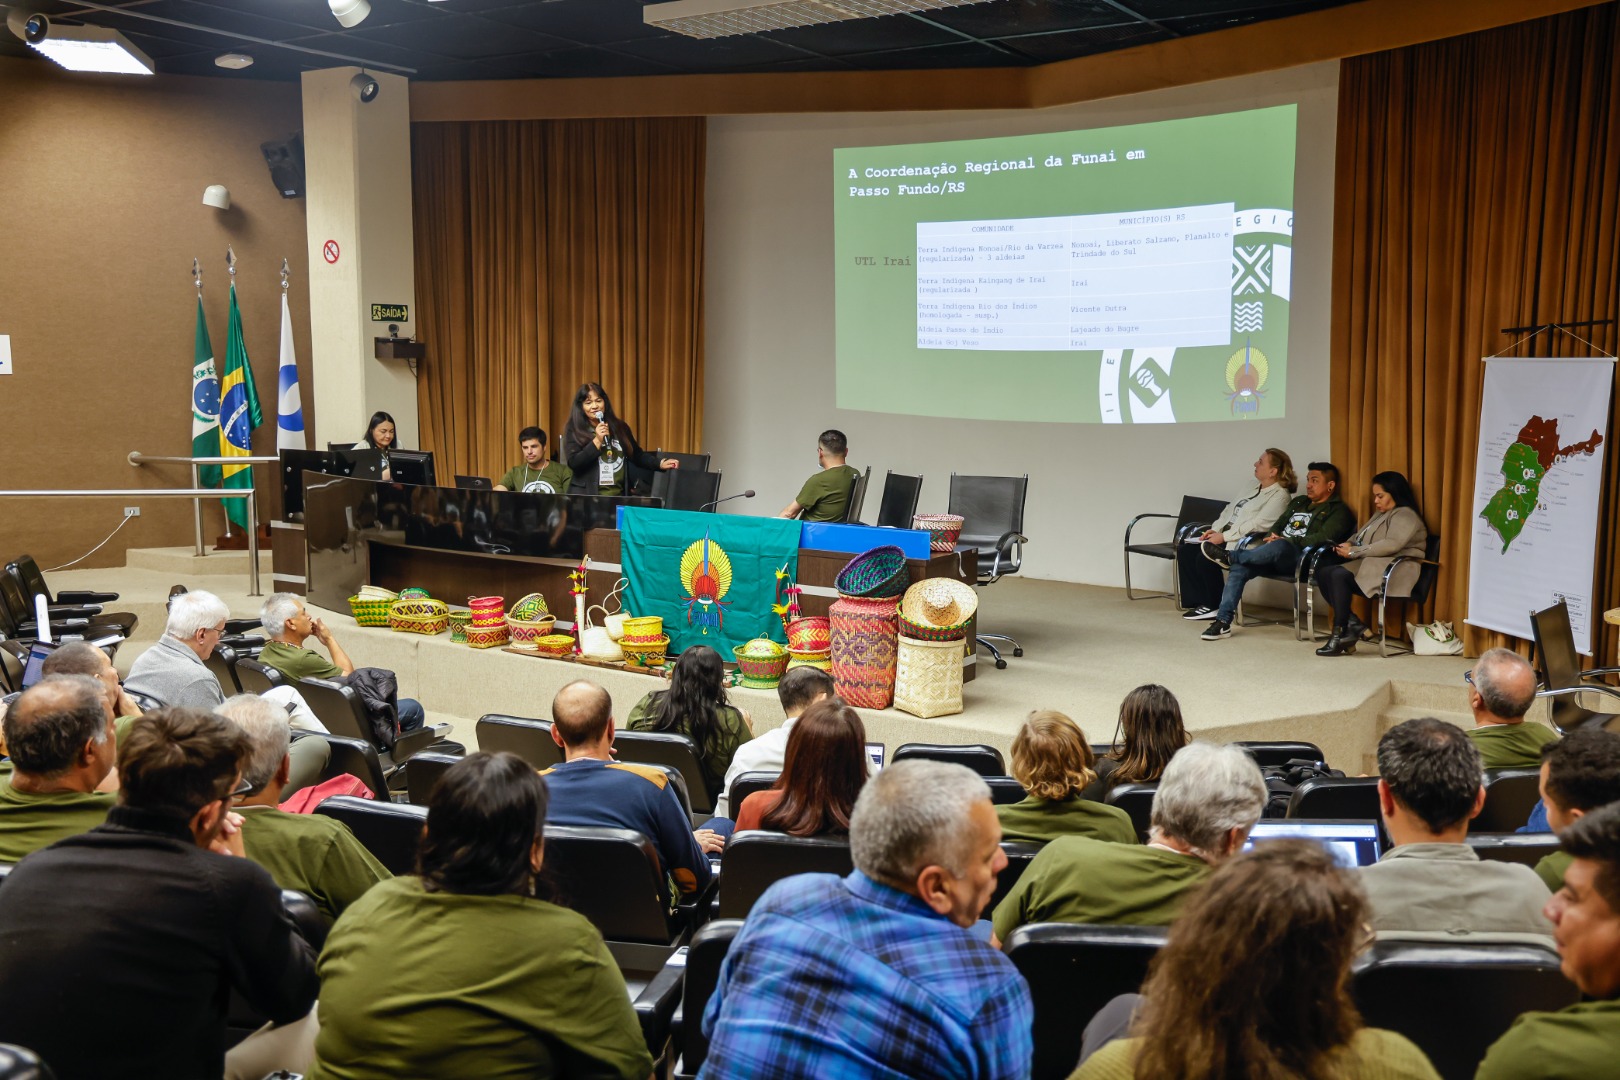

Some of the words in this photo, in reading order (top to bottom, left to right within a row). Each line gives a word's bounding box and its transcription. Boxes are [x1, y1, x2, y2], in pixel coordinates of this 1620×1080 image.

[848, 168, 858, 179] A
[865, 162, 956, 179] Coordenação
[965, 158, 1035, 175] Regional
[1044, 154, 1062, 168] da
[1072, 150, 1116, 165] Funai
[1126, 149, 1146, 160] em
[849, 185, 889, 197] Passo
[898, 182, 965, 196] Fundo/RS
[1119, 215, 1171, 225] MUNICÍPIO(S)
[1146, 236, 1180, 244] Salzano,
[1185, 232, 1220, 241] Planalto
[854, 256, 877, 266] UTL
[884, 255, 911, 266] Iraí
[918, 254, 974, 263] (regularizada)
[382, 306, 401, 318] SAÍDA
[974, 312, 999, 320] susp.)
[692, 609, 718, 627] FUNAI
